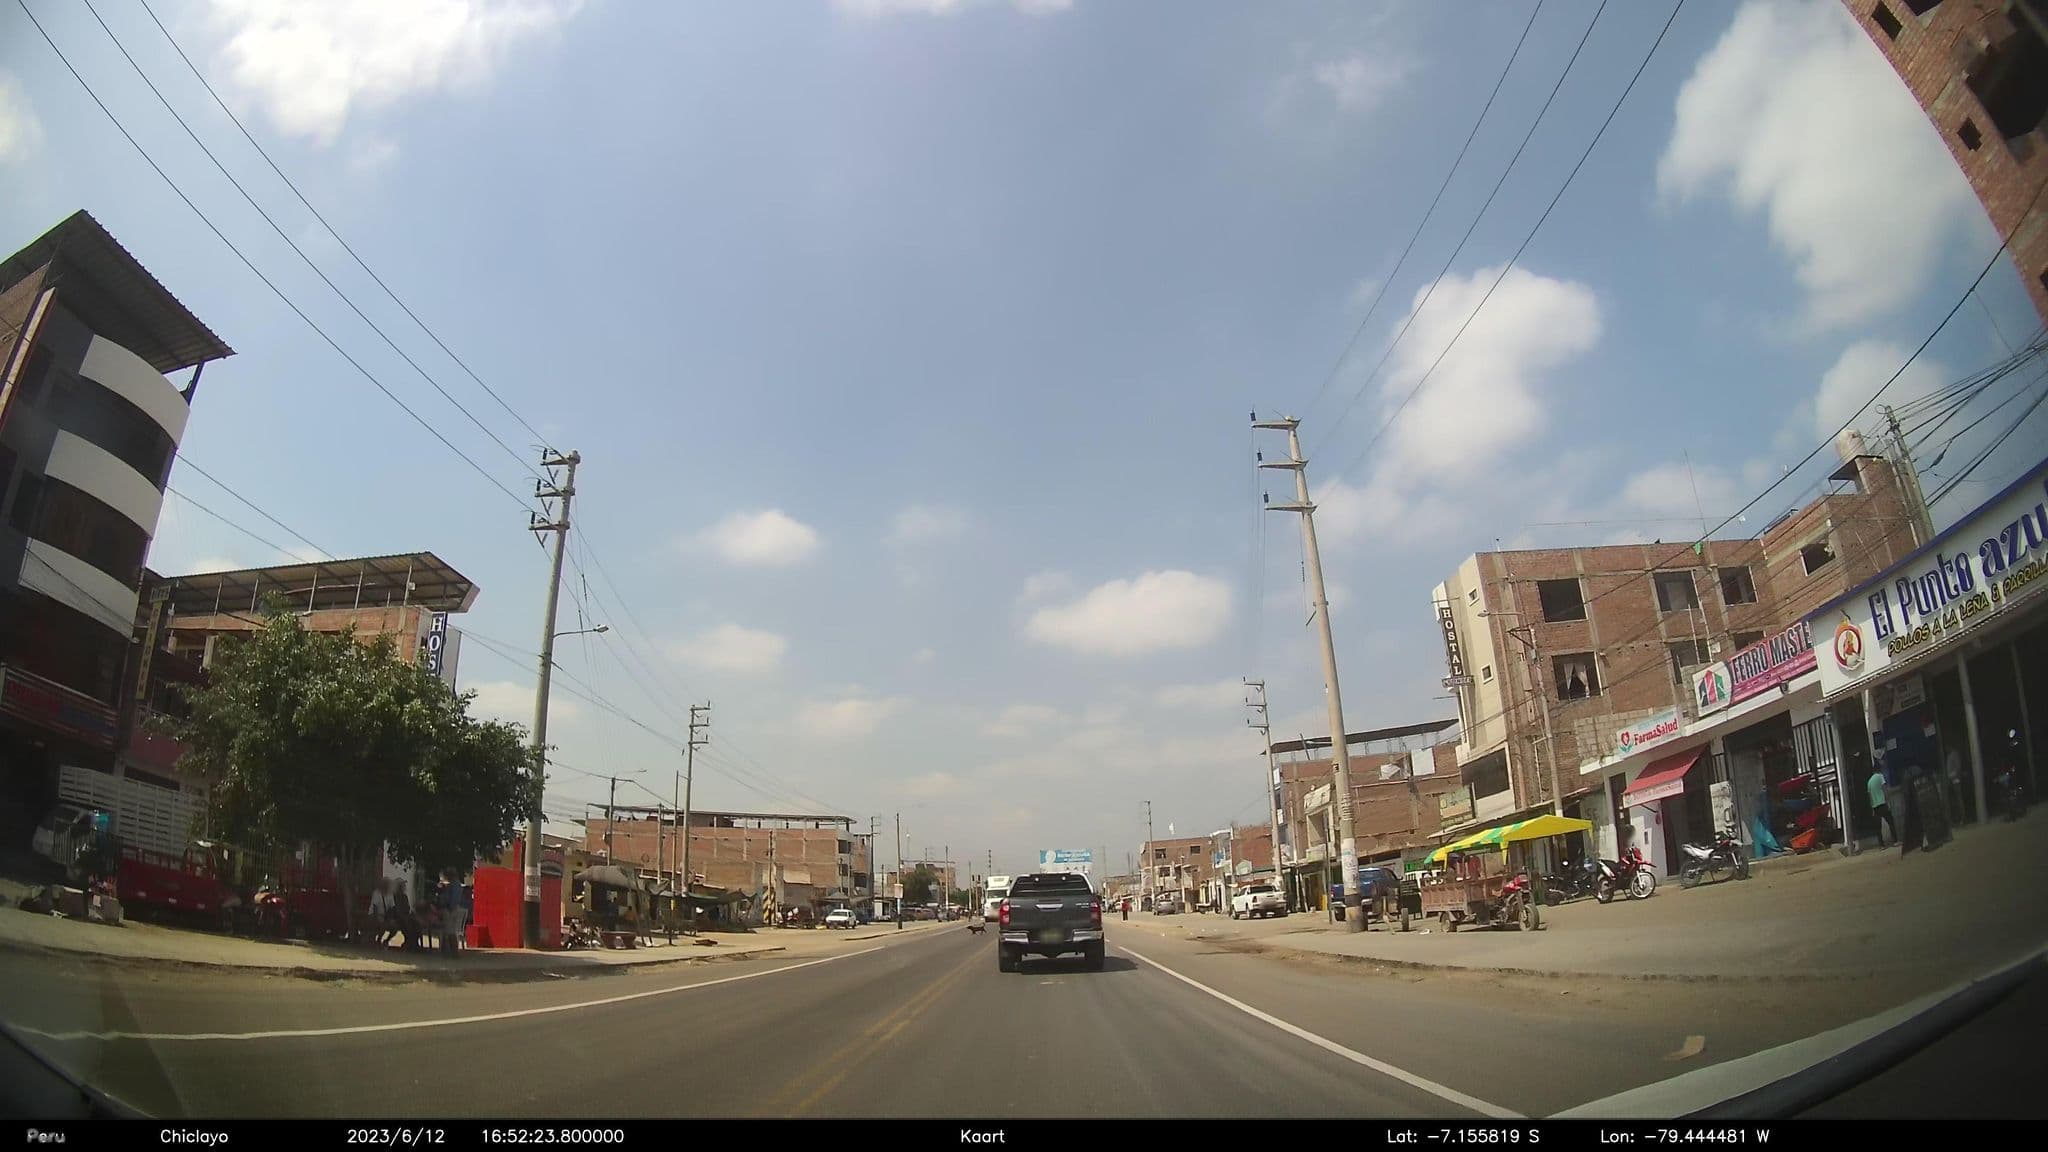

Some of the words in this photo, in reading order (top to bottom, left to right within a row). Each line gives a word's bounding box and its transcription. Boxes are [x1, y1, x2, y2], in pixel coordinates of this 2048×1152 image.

[1868, 588, 1894, 640] El
[1896, 553, 1974, 625] Punto
[1888, 623, 1930, 657] POLLOS
[1933, 617, 1942, 635] A
[1943, 608, 1958, 629] LA
[1991, 583, 2000, 601] &
[2003, 552, 2048, 596] PARRILL
[428, 616, 443, 676] HOS
[1442, 609, 1462, 675] HOSTAL
[1732, 644, 1768, 684] FERRO
[1634, 718, 1678, 745] FarmaSalud
